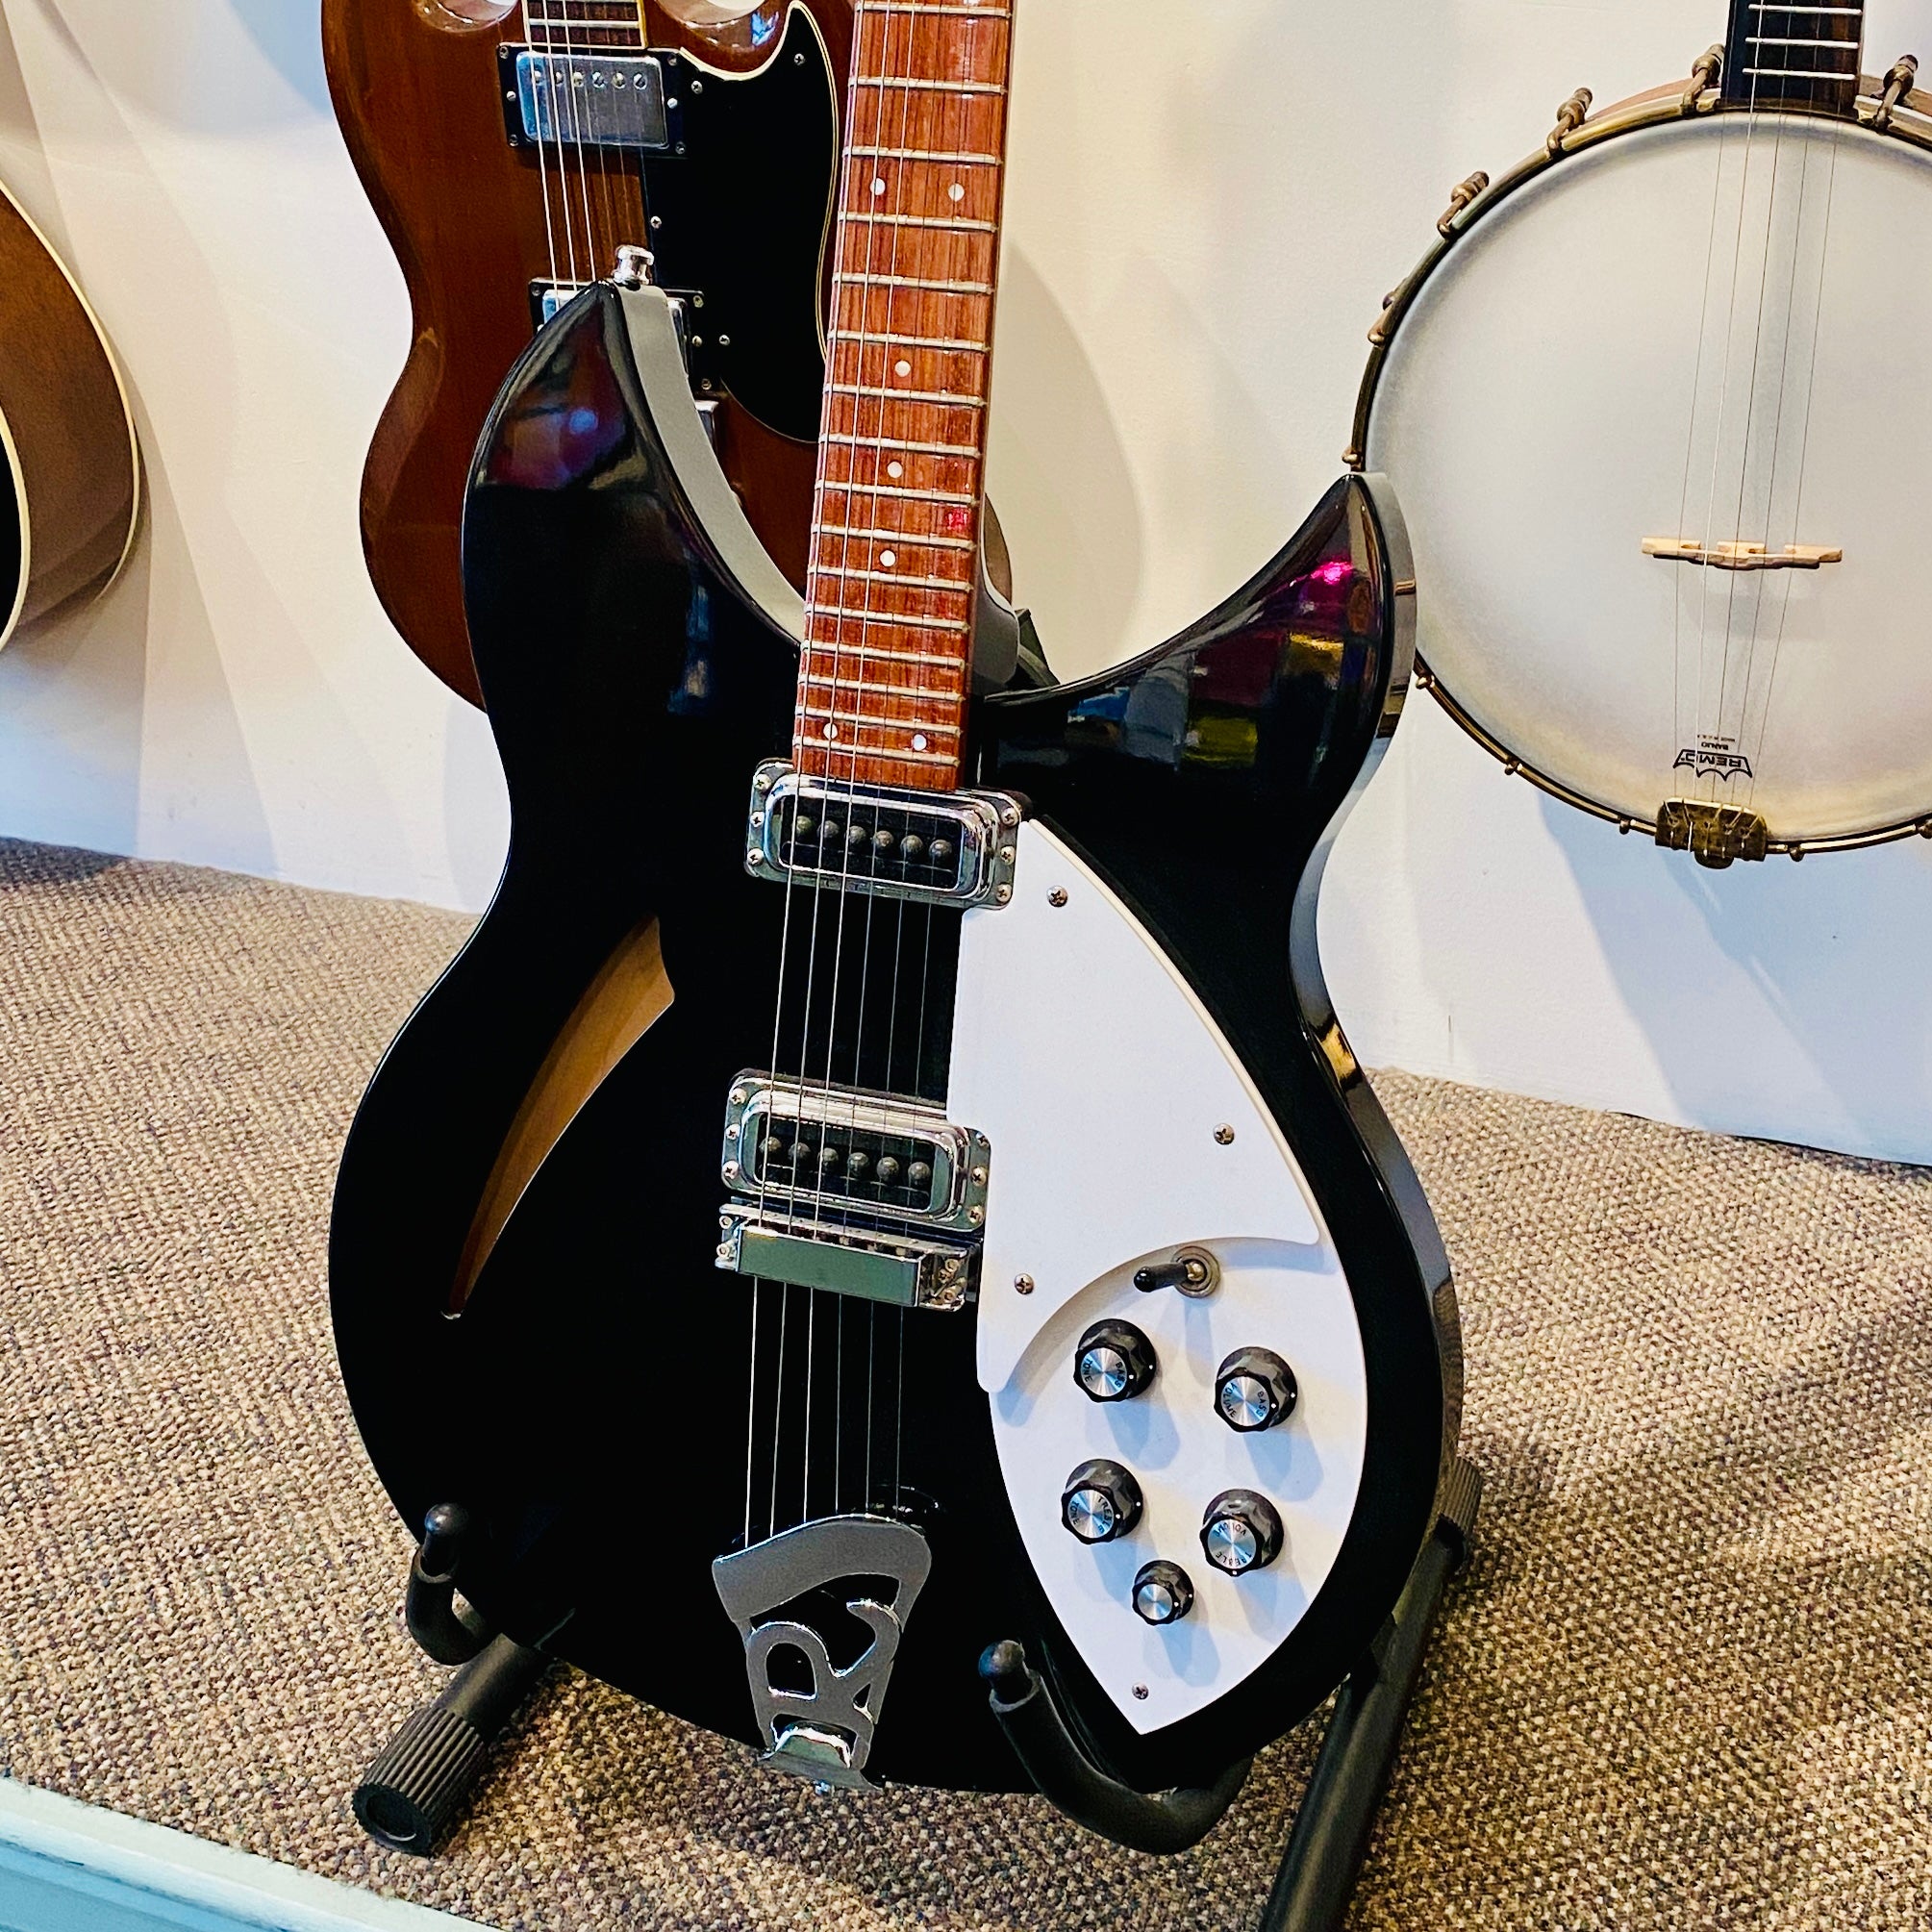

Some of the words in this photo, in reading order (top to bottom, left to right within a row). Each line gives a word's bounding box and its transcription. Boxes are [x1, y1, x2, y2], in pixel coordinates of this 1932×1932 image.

[1685, 752, 1742, 767] REMO
[1082, 1358, 1093, 1383] TONE
[1115, 1361, 1126, 1388] BASS
[1222, 1382, 1238, 1418] VOLUME
[1257, 1391, 1267, 1418] BASS
[1069, 1500, 1080, 1525] TONE
[1097, 1495, 1113, 1534] TREBLE
[1214, 1551, 1252, 1567] TREBLE
